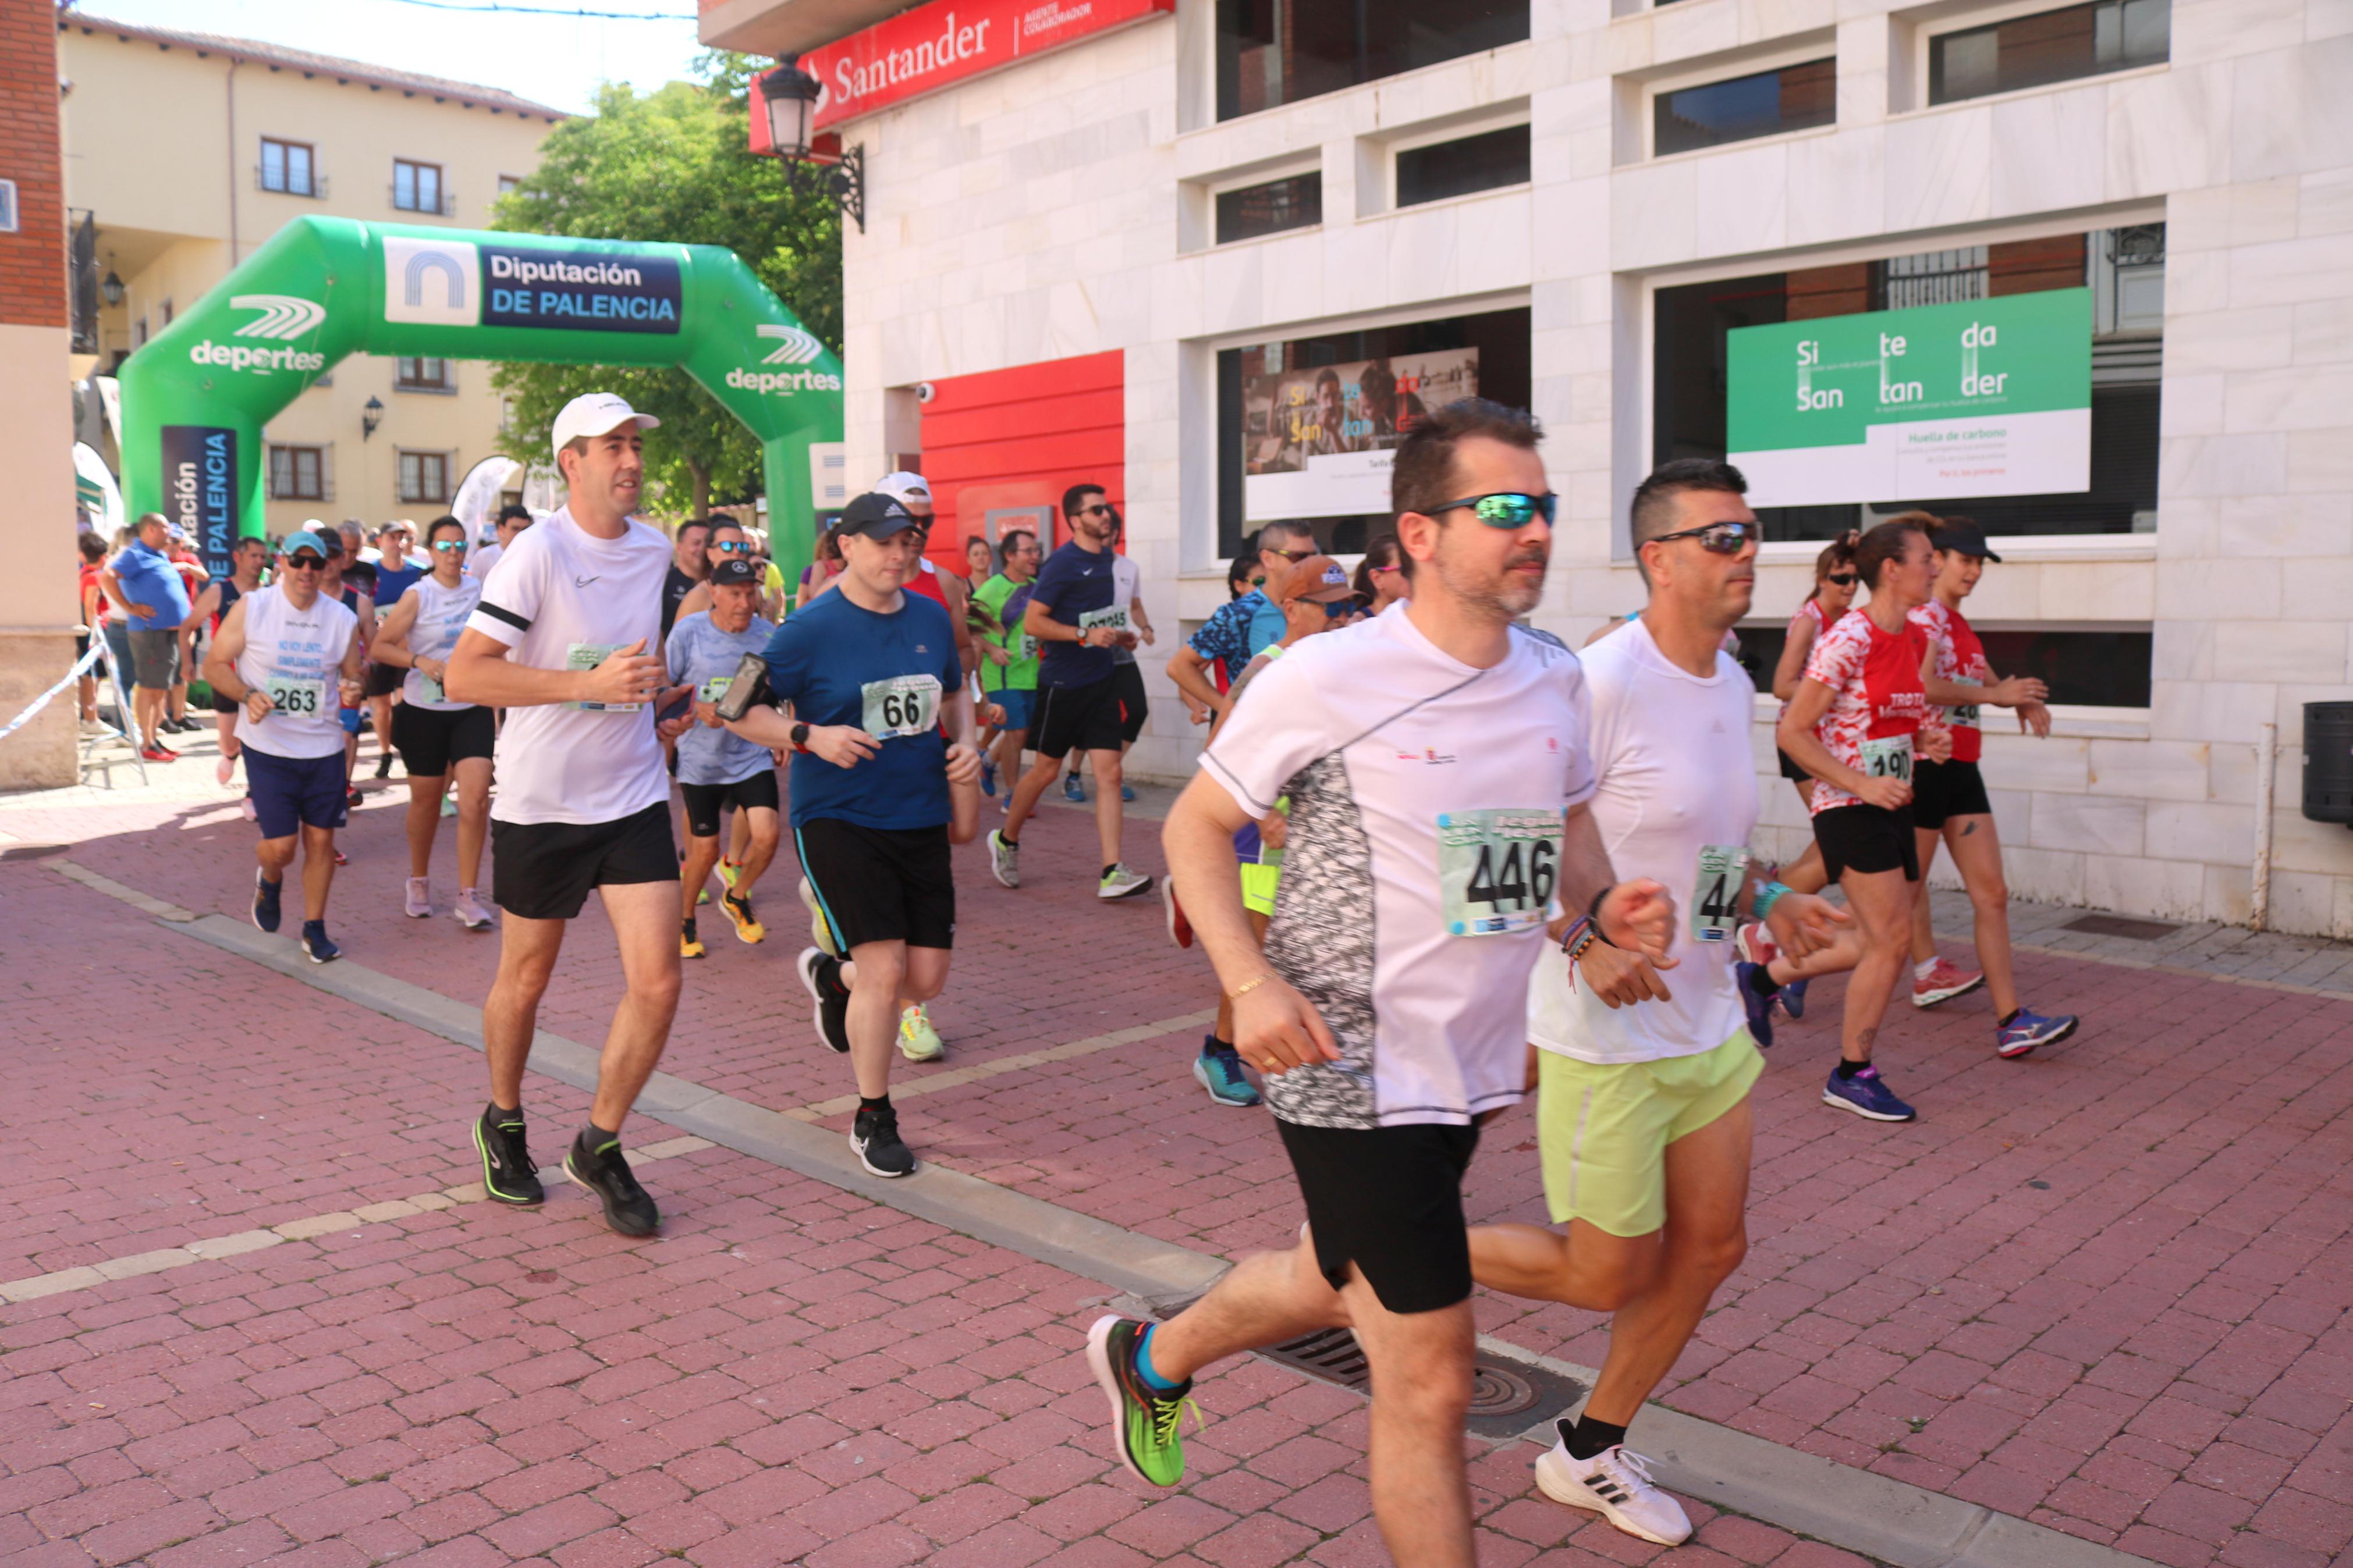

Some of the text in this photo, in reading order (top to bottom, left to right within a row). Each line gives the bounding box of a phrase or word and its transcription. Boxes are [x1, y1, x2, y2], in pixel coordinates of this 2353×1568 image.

[835, 12, 991, 105] Santander
[491, 254, 641, 286] Diputación
[492, 288, 675, 321] DE PALENCIA
[190, 339, 325, 372] deportes
[1797, 341, 1818, 367] Si
[1880, 332, 1907, 358] te
[1961, 322, 1997, 349] da
[725, 367, 842, 394] deportes
[1797, 372, 2008, 411] San tan der
[1908, 428, 2007, 443] Huella de carbono
[205, 432, 229, 553] PALENCIA
[274, 687, 315, 712] 263
[883, 692, 920, 728] 66
[1467, 840, 1556, 912] 446
